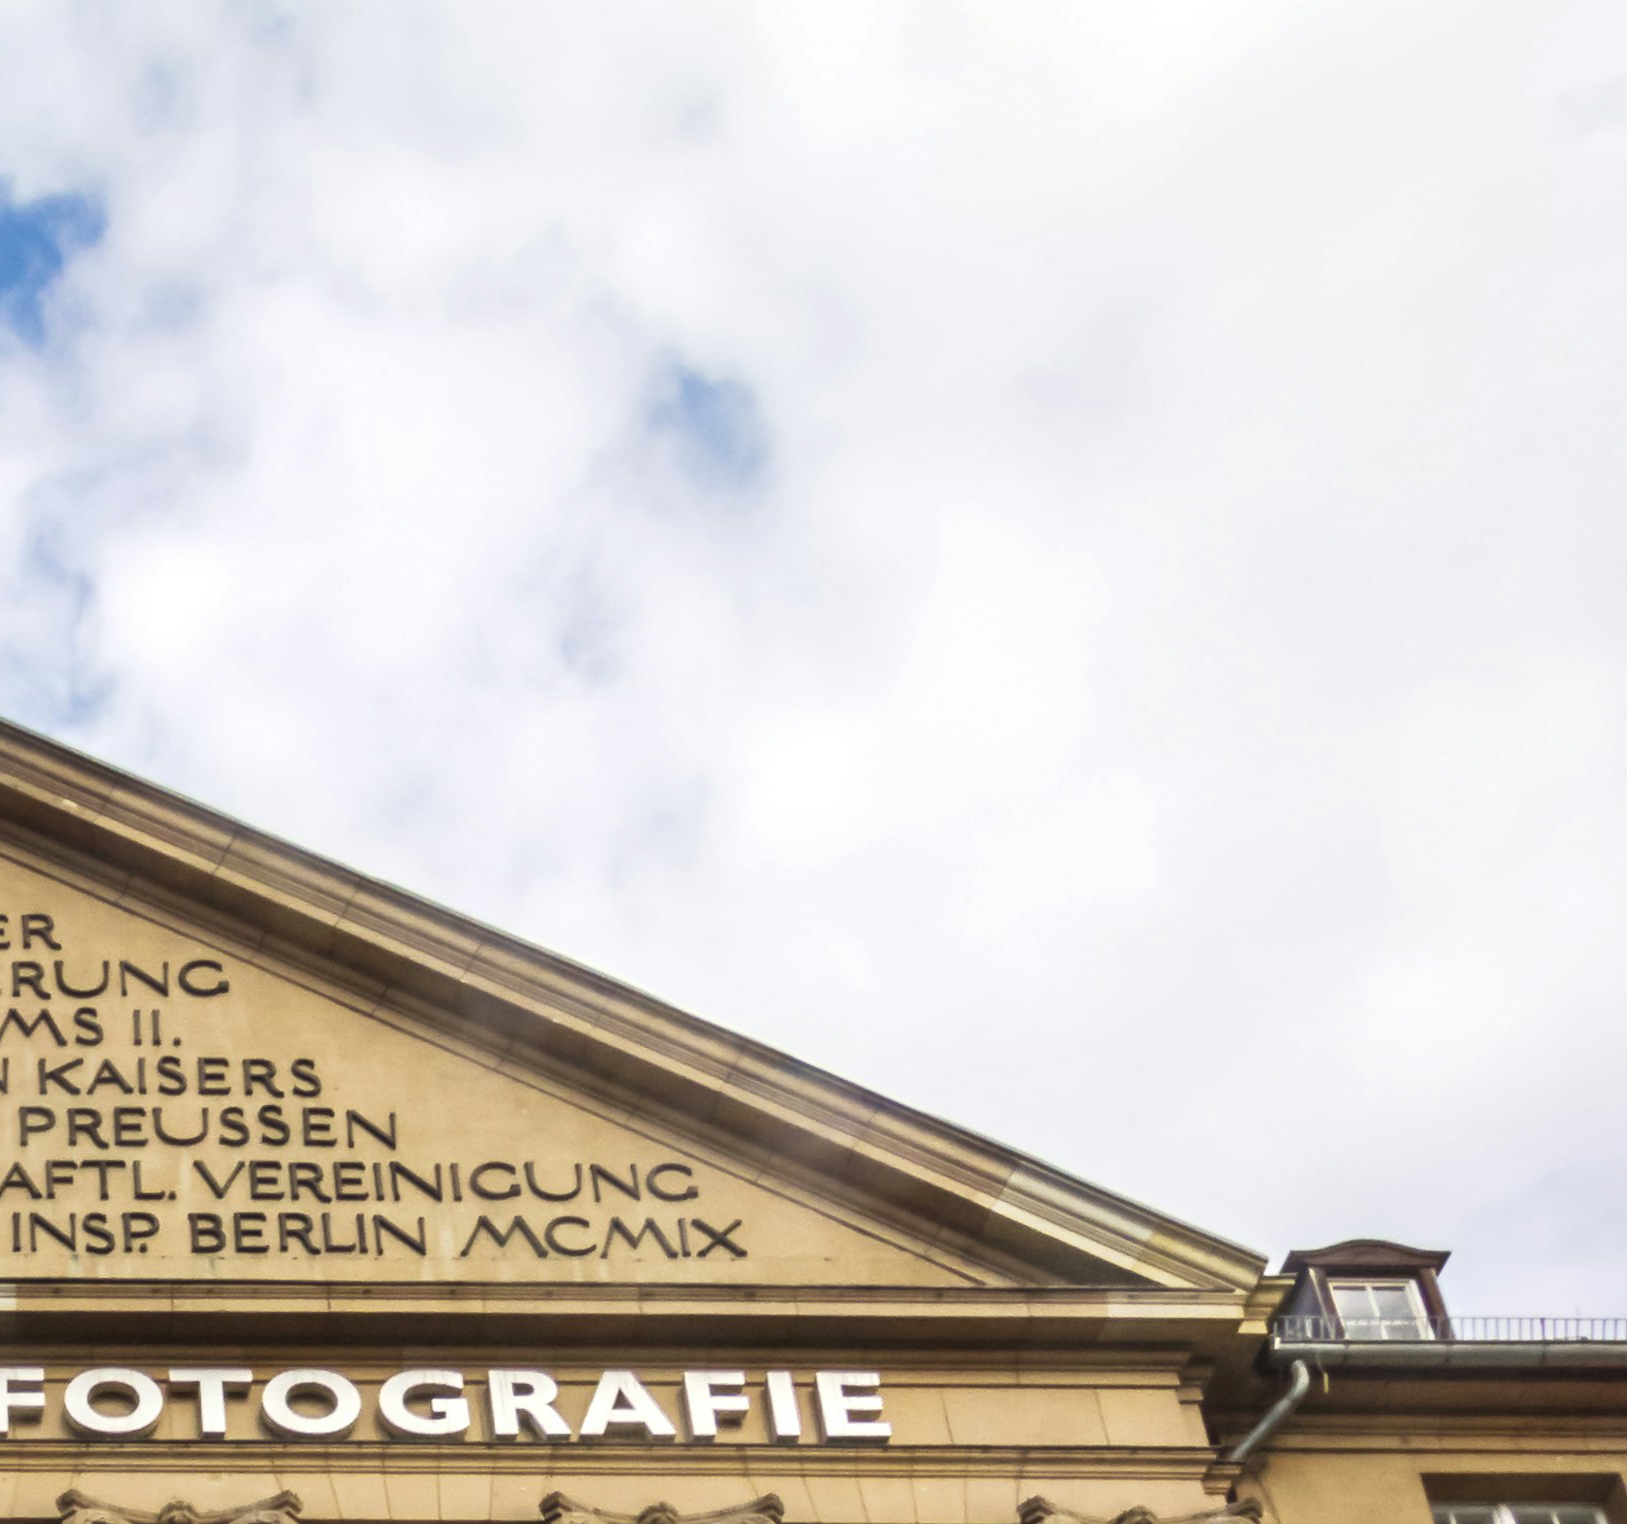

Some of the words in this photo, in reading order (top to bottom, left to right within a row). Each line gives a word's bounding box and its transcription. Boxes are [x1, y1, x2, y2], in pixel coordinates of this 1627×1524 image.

[134, 1011, 180, 1046] II.
[39, 1057, 320, 1098] KAISERS
[20, 1108, 396, 1150] PREUSSEN
[194, 1161, 698, 1203] VEREINIGUNG
[13, 1213, 159, 1255] INSP.
[188, 1213, 426, 1255] BERLIN
[461, 1216, 747, 1258] MCMIX
